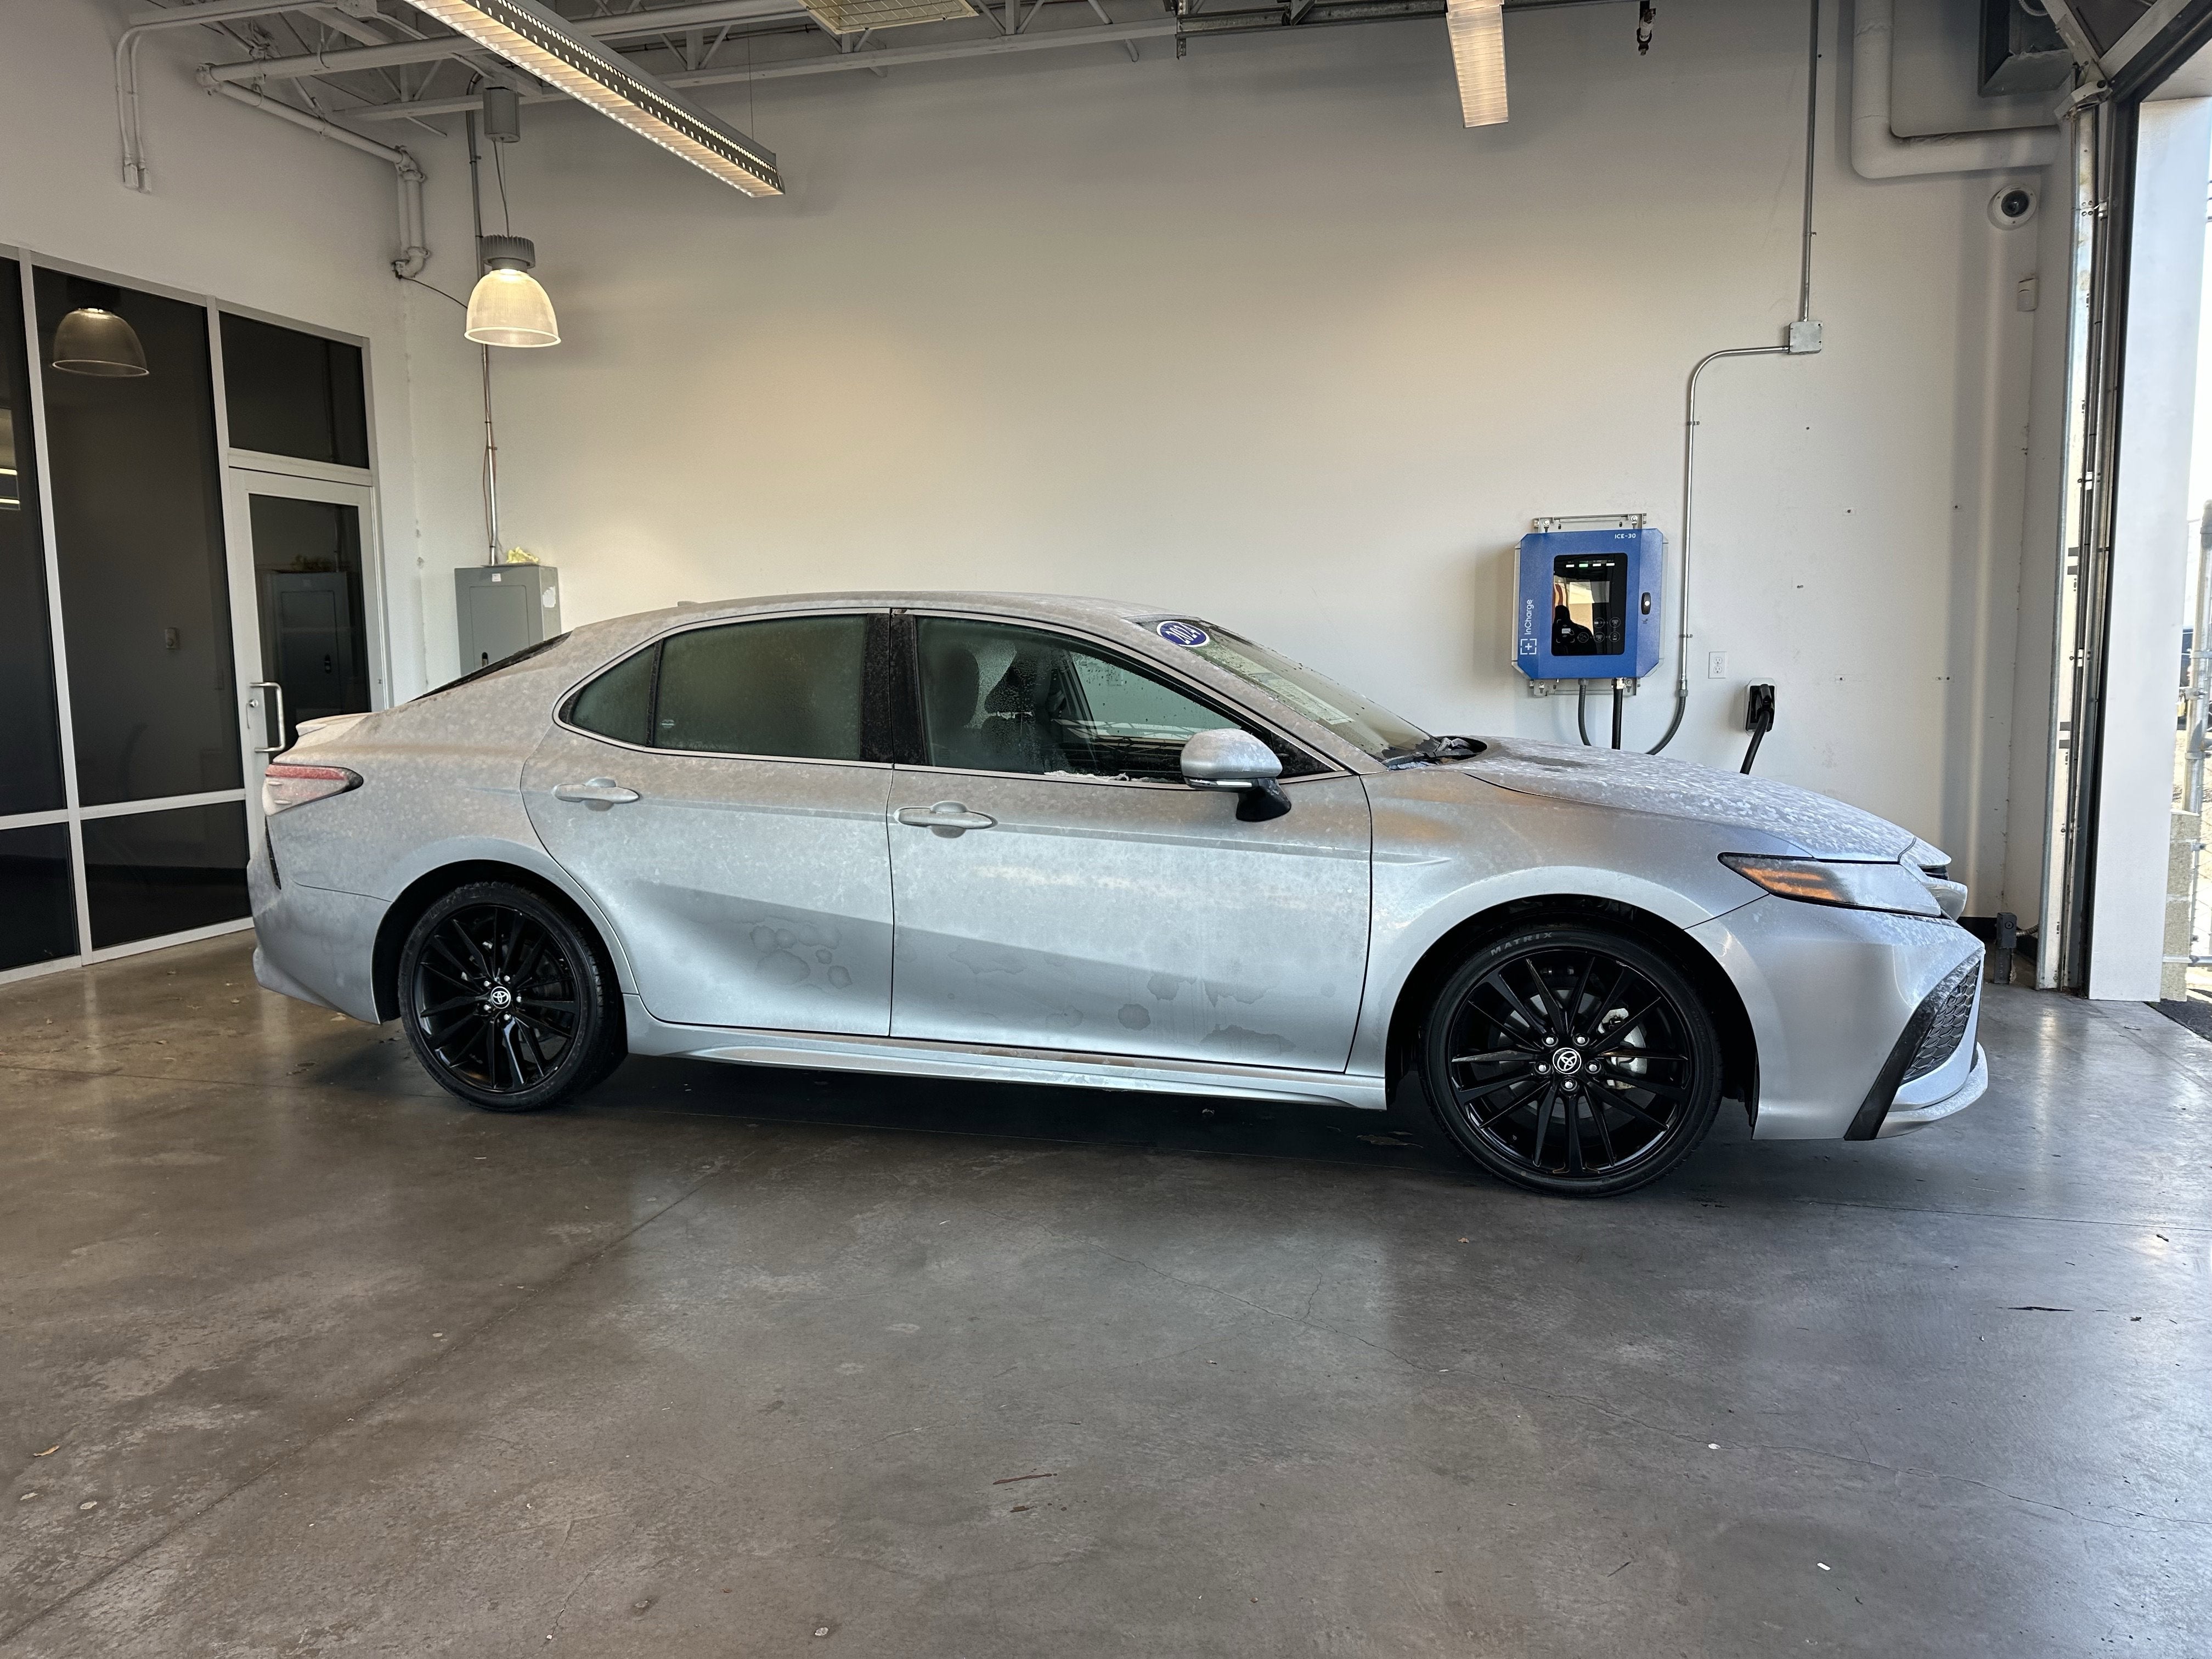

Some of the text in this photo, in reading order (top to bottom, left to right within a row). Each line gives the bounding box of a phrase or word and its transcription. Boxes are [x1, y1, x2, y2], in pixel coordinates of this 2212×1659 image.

[1524, 599, 1534, 635] InCharge
[1165, 623, 1201, 645] 2024
[1490, 932, 1553, 956] MATRIX
